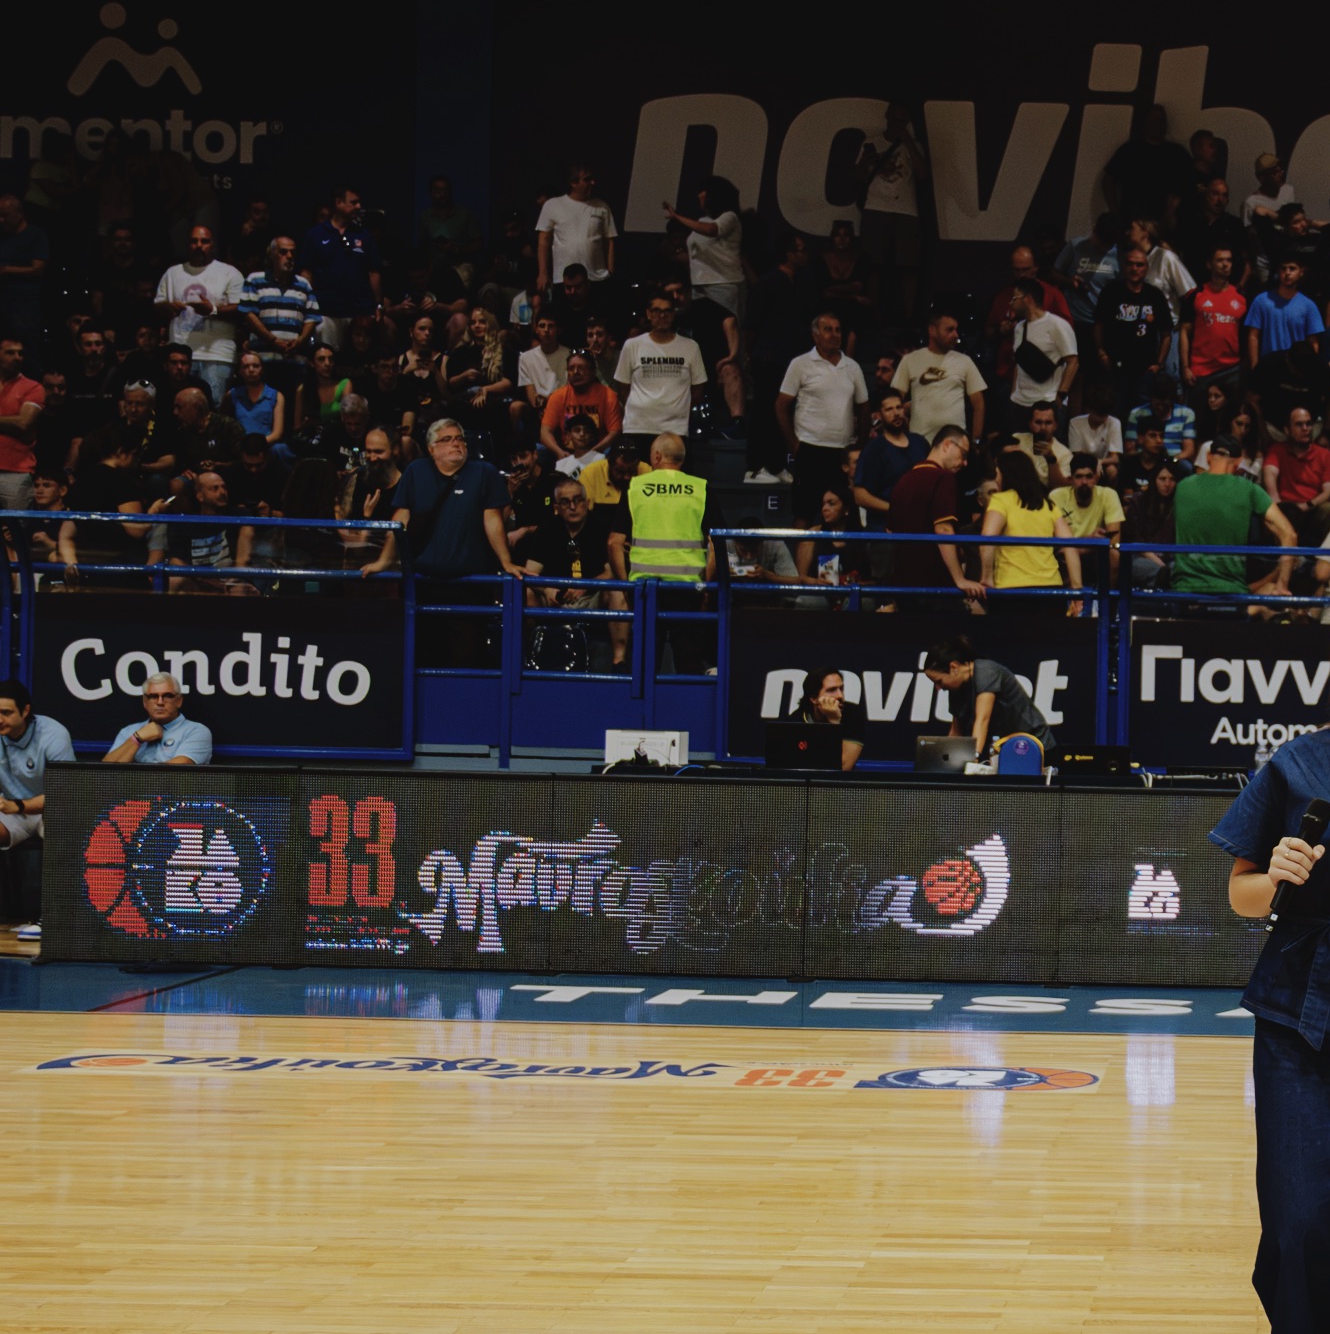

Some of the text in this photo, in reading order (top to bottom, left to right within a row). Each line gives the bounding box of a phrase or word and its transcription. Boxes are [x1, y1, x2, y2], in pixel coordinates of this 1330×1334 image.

[656, 484, 694, 495] BMS
[60, 632, 371, 706] Condito
[307, 795, 397, 908] 33
